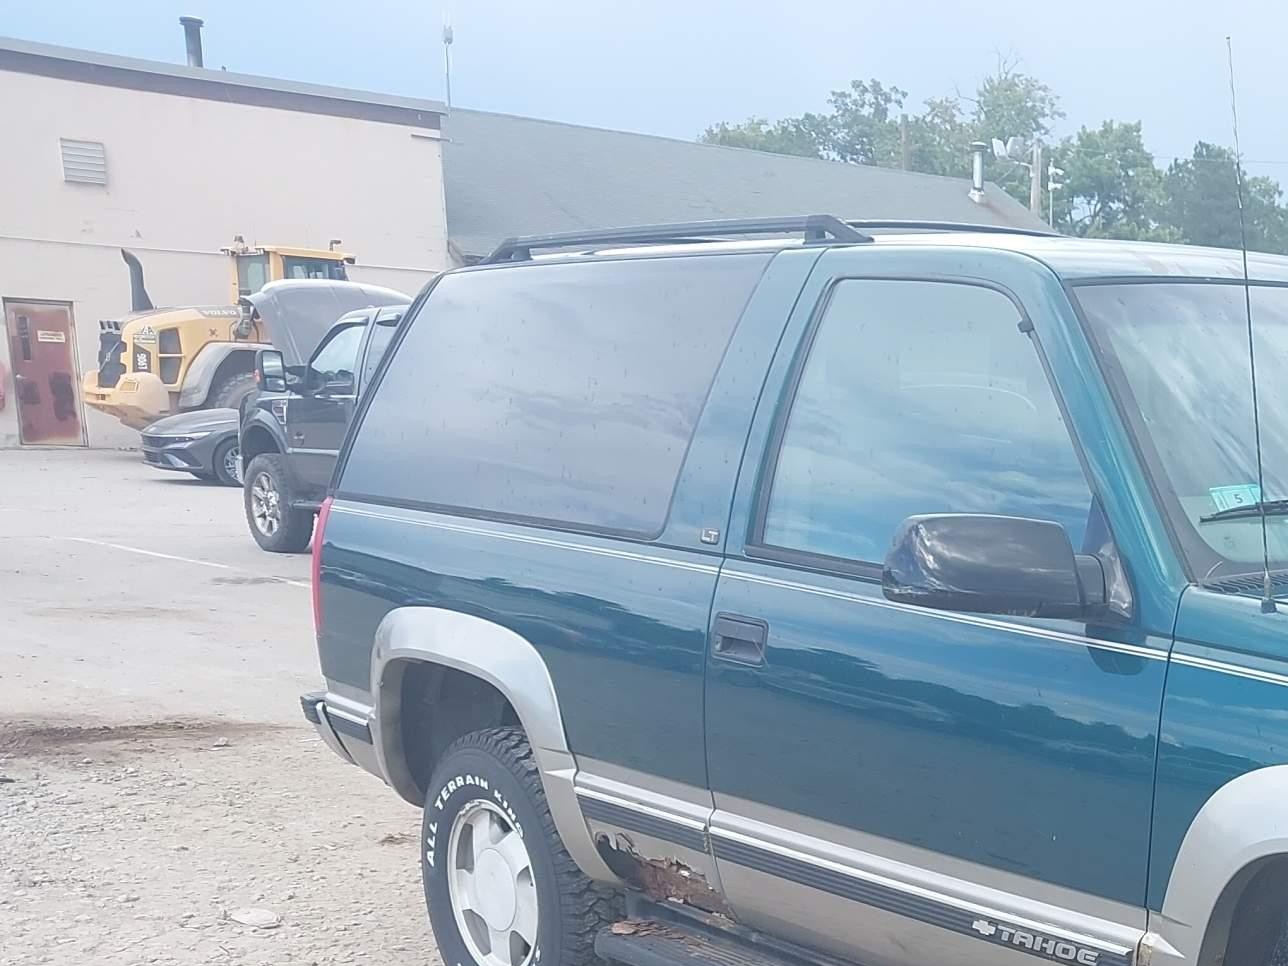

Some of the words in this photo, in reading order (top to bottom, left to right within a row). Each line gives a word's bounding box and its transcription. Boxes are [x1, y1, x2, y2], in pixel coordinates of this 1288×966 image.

[1234, 493, 1244, 504] 5
[701, 528, 719, 542] LT
[426, 822, 438, 868] ALL
[434, 774, 490, 811] TERRAIN
